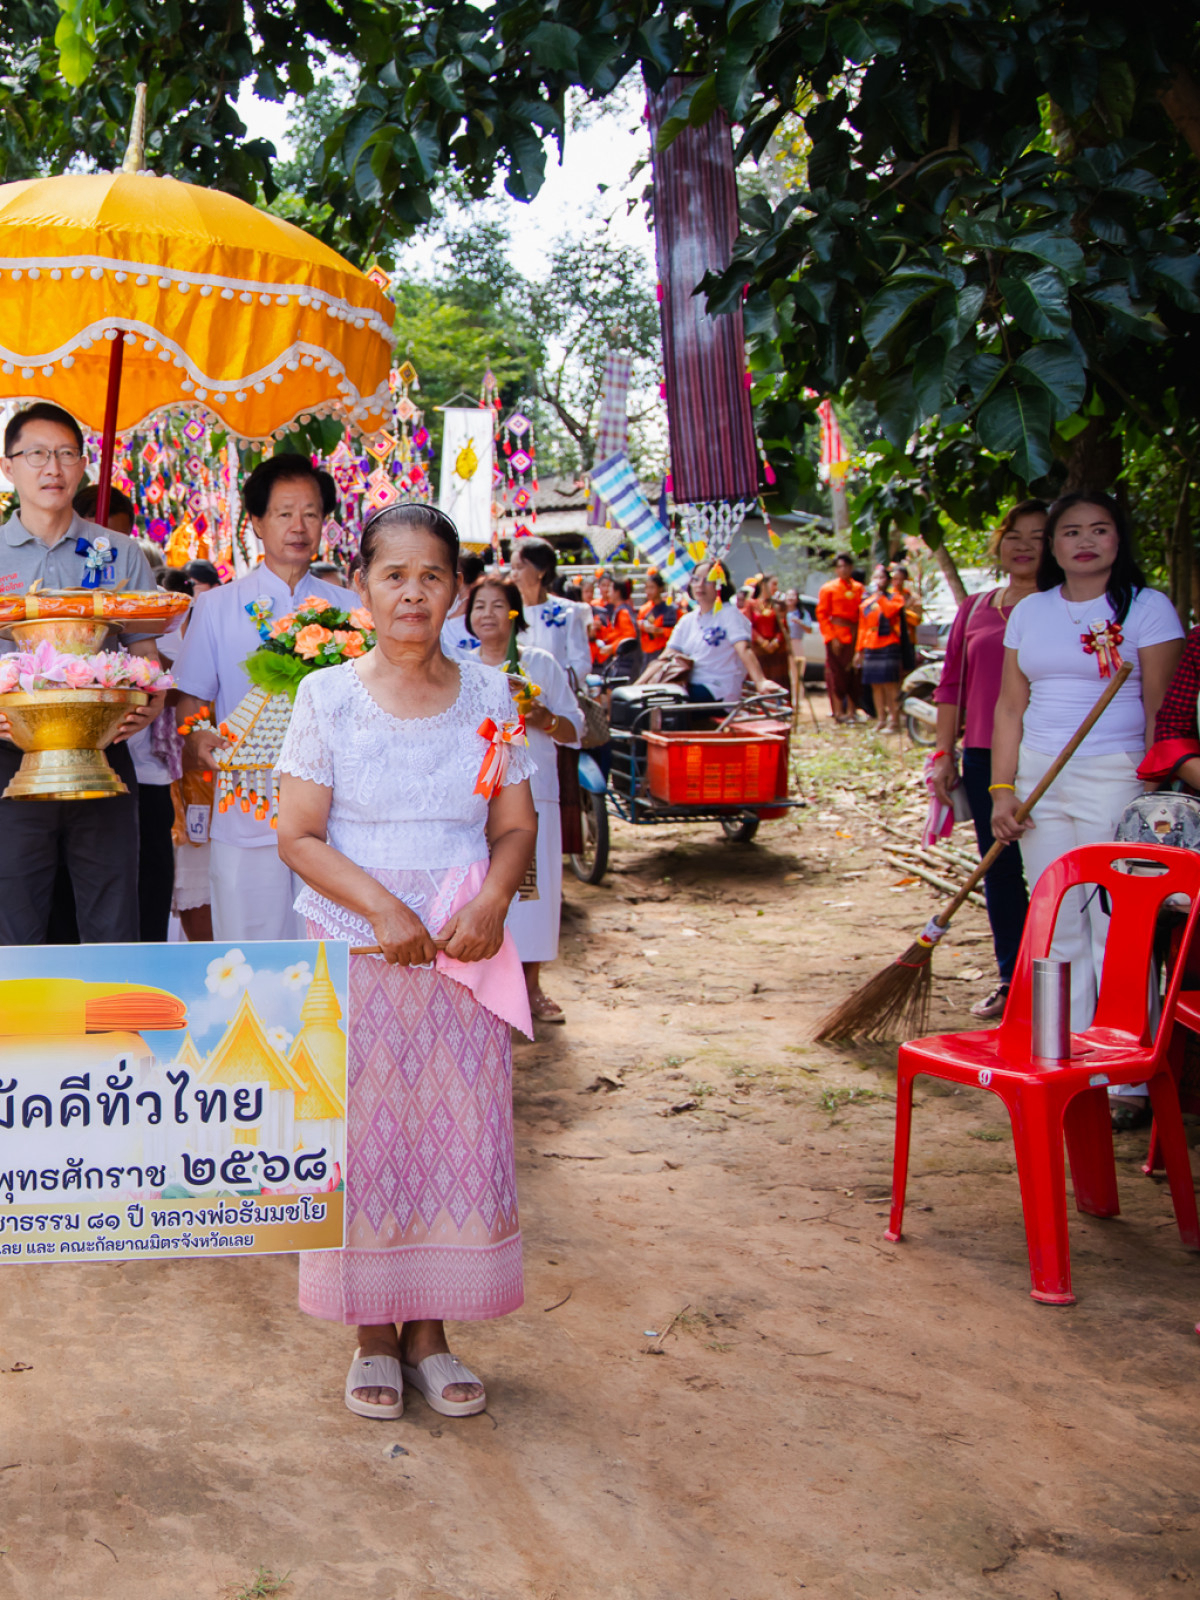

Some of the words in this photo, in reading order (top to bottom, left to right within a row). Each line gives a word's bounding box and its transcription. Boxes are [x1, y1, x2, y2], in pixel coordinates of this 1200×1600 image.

[181, 1148, 327, 1186] ๒๕๖๘
[87, 1212, 121, 1231] ๘๑
[127, 1204, 144, 1228] ปี
[151, 1197, 326, 1227] หลวงพ่อธัมมชโย
[27, 1241, 55, 1254] และ
[60, 1232, 254, 1254] คณะกัลยาณมิตรจังหวัดเลย
